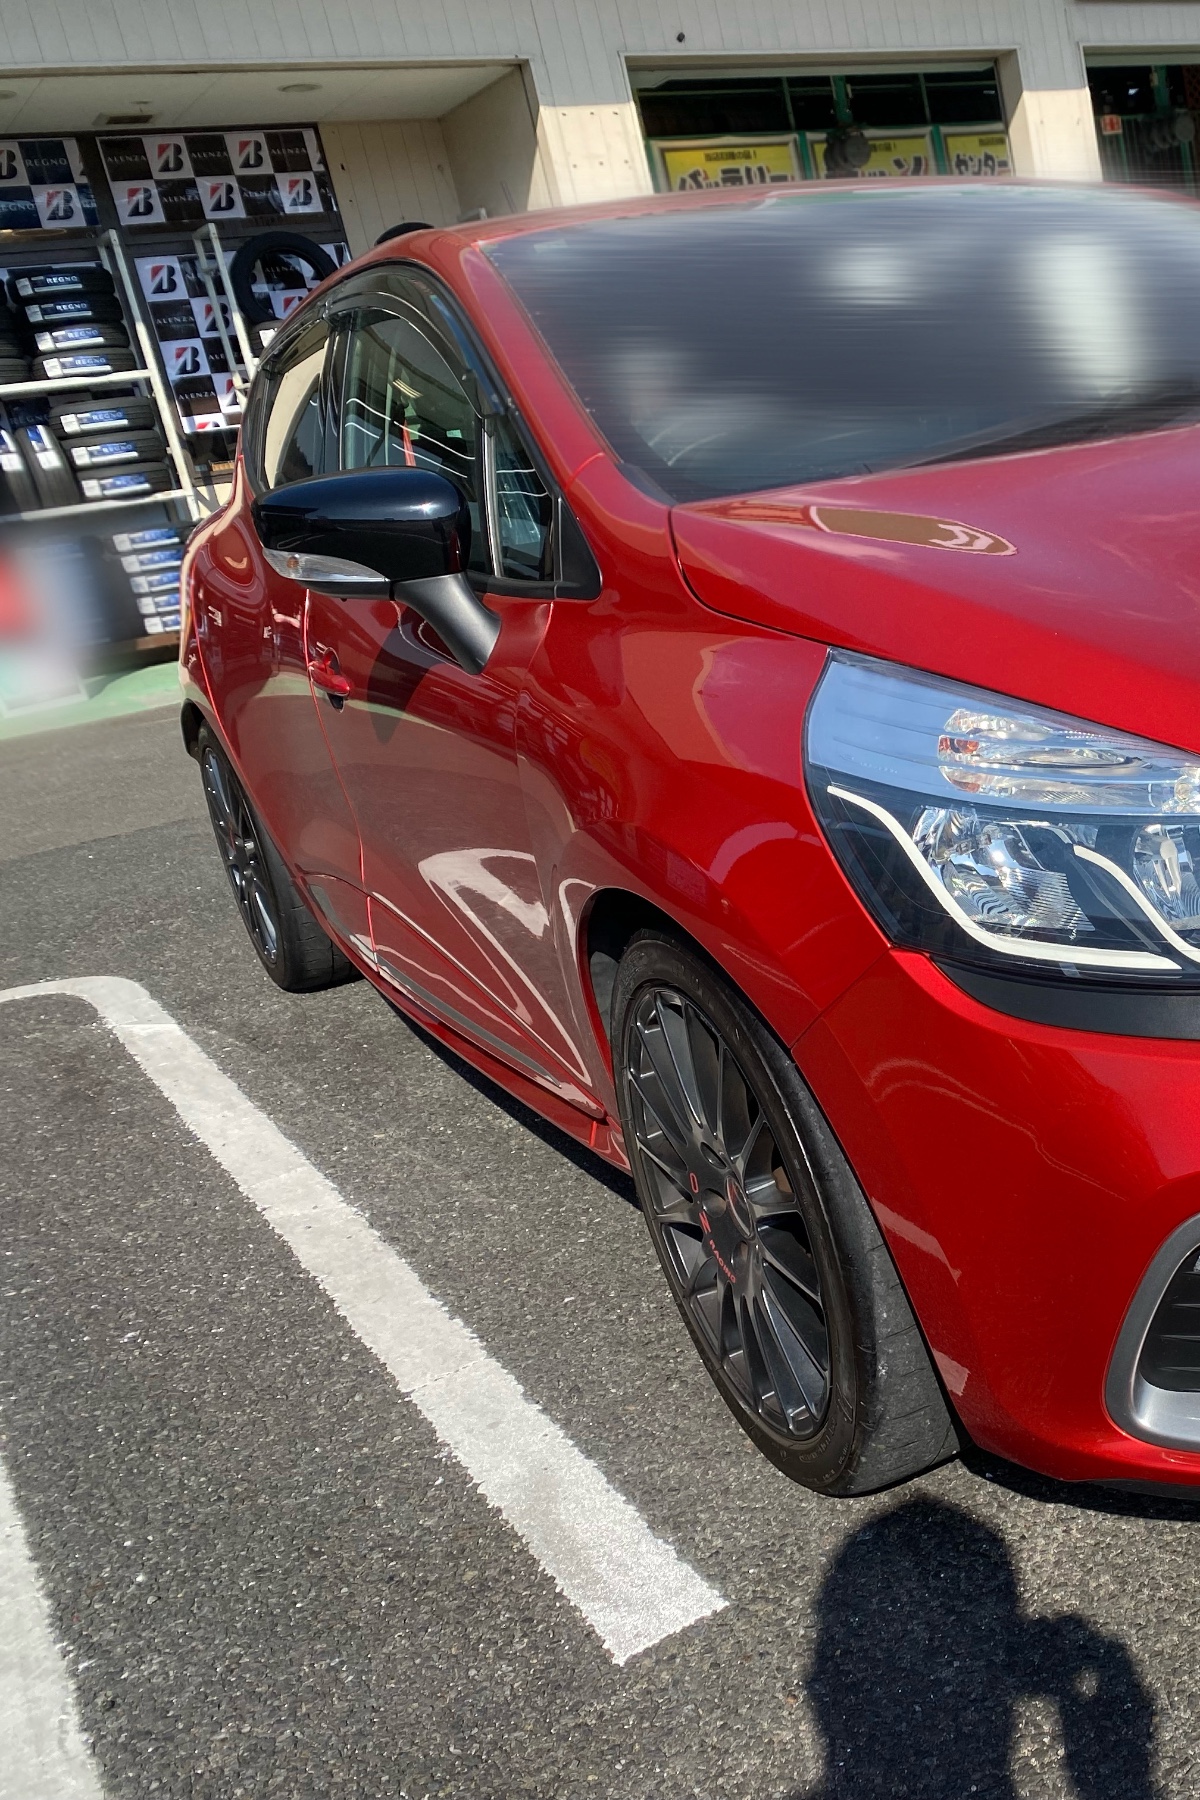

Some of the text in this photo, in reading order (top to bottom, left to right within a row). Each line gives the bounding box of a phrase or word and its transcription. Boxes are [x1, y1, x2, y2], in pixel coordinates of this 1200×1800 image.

[26, 157, 68, 168] REGNO
[46, 275, 78, 284] REGNO
[56, 303, 87, 311] REGNO
[156, 315, 195, 325] ALENZA
[67, 329, 98, 338] REGNO
[75, 357, 106, 366] REGNO
[179, 391, 216, 401] ALENZA
[92, 412, 124, 421] REGNO
[102, 443, 134, 453] REGNO
[709, 1239, 736, 1284] RACING
